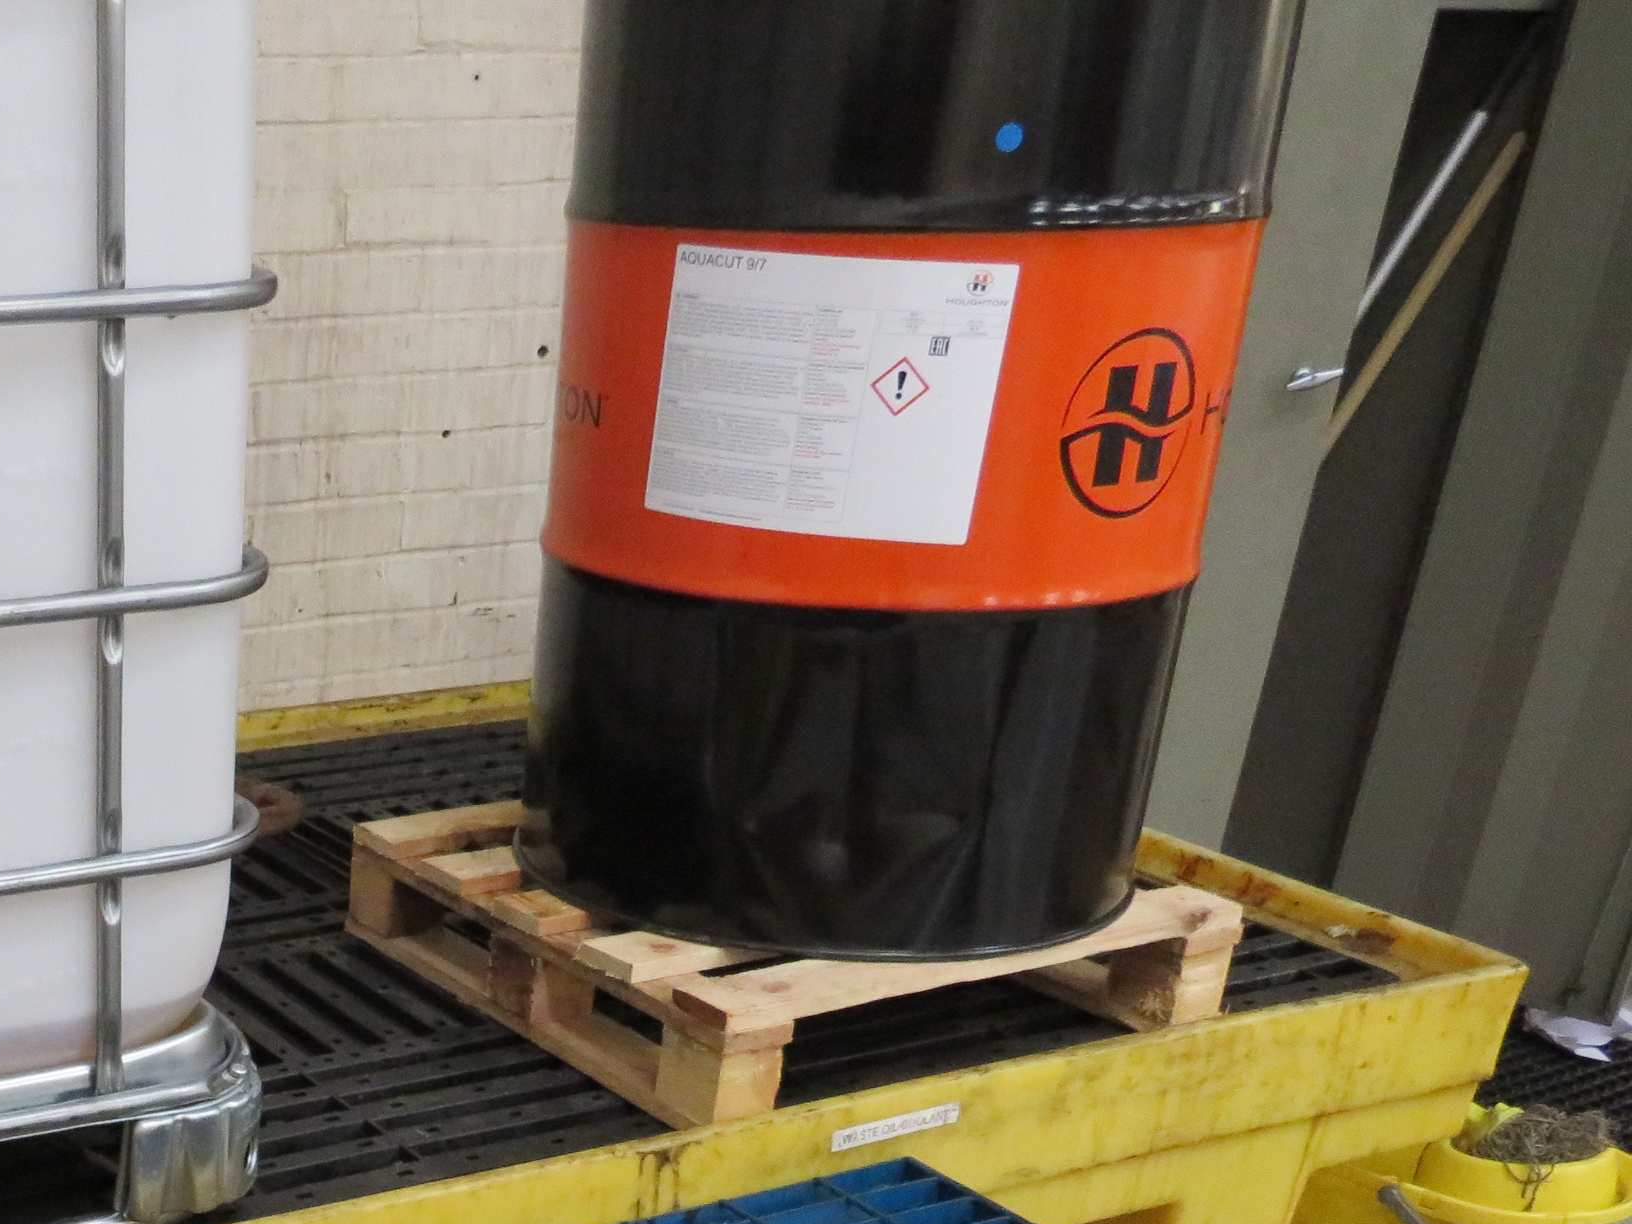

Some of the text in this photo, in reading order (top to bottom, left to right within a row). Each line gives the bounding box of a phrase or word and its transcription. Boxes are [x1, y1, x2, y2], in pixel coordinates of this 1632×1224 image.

[679, 250, 768, 272] AQUACUT 9/7
[562, 384, 602, 427] ON
